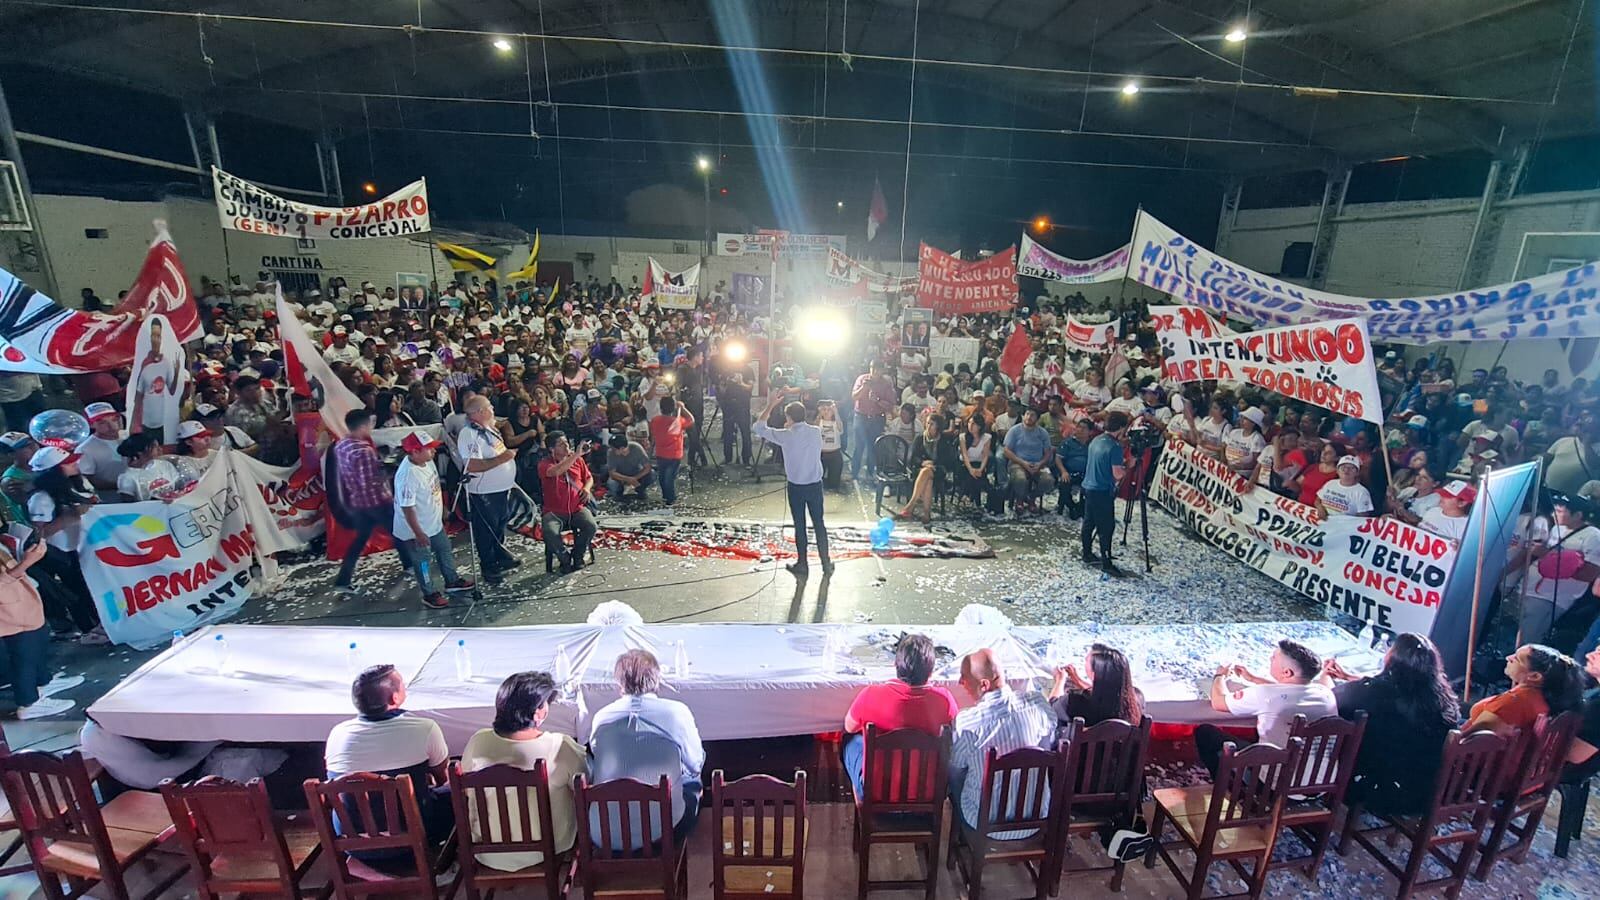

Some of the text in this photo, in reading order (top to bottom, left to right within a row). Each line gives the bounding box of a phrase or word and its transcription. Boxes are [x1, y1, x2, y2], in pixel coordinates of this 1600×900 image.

[227, 202, 289, 224] JUJUY
[233, 217, 287, 235] (GEN)
[314, 195, 427, 226] PIZARRO
[330, 219, 422, 239] CONCEJAL
[262, 256, 323, 269] CANTINA
[1163, 358, 1234, 383] AREA
[1241, 365, 1364, 418] ZOONOSIS
[1191, 450, 1247, 494] HERNAN
[1256, 507, 1327, 547] PONCIO
[1273, 537, 1325, 568] PROV.
[1349, 535, 1446, 588] DI BELLO
[1280, 560, 1392, 628] PRESENTE
